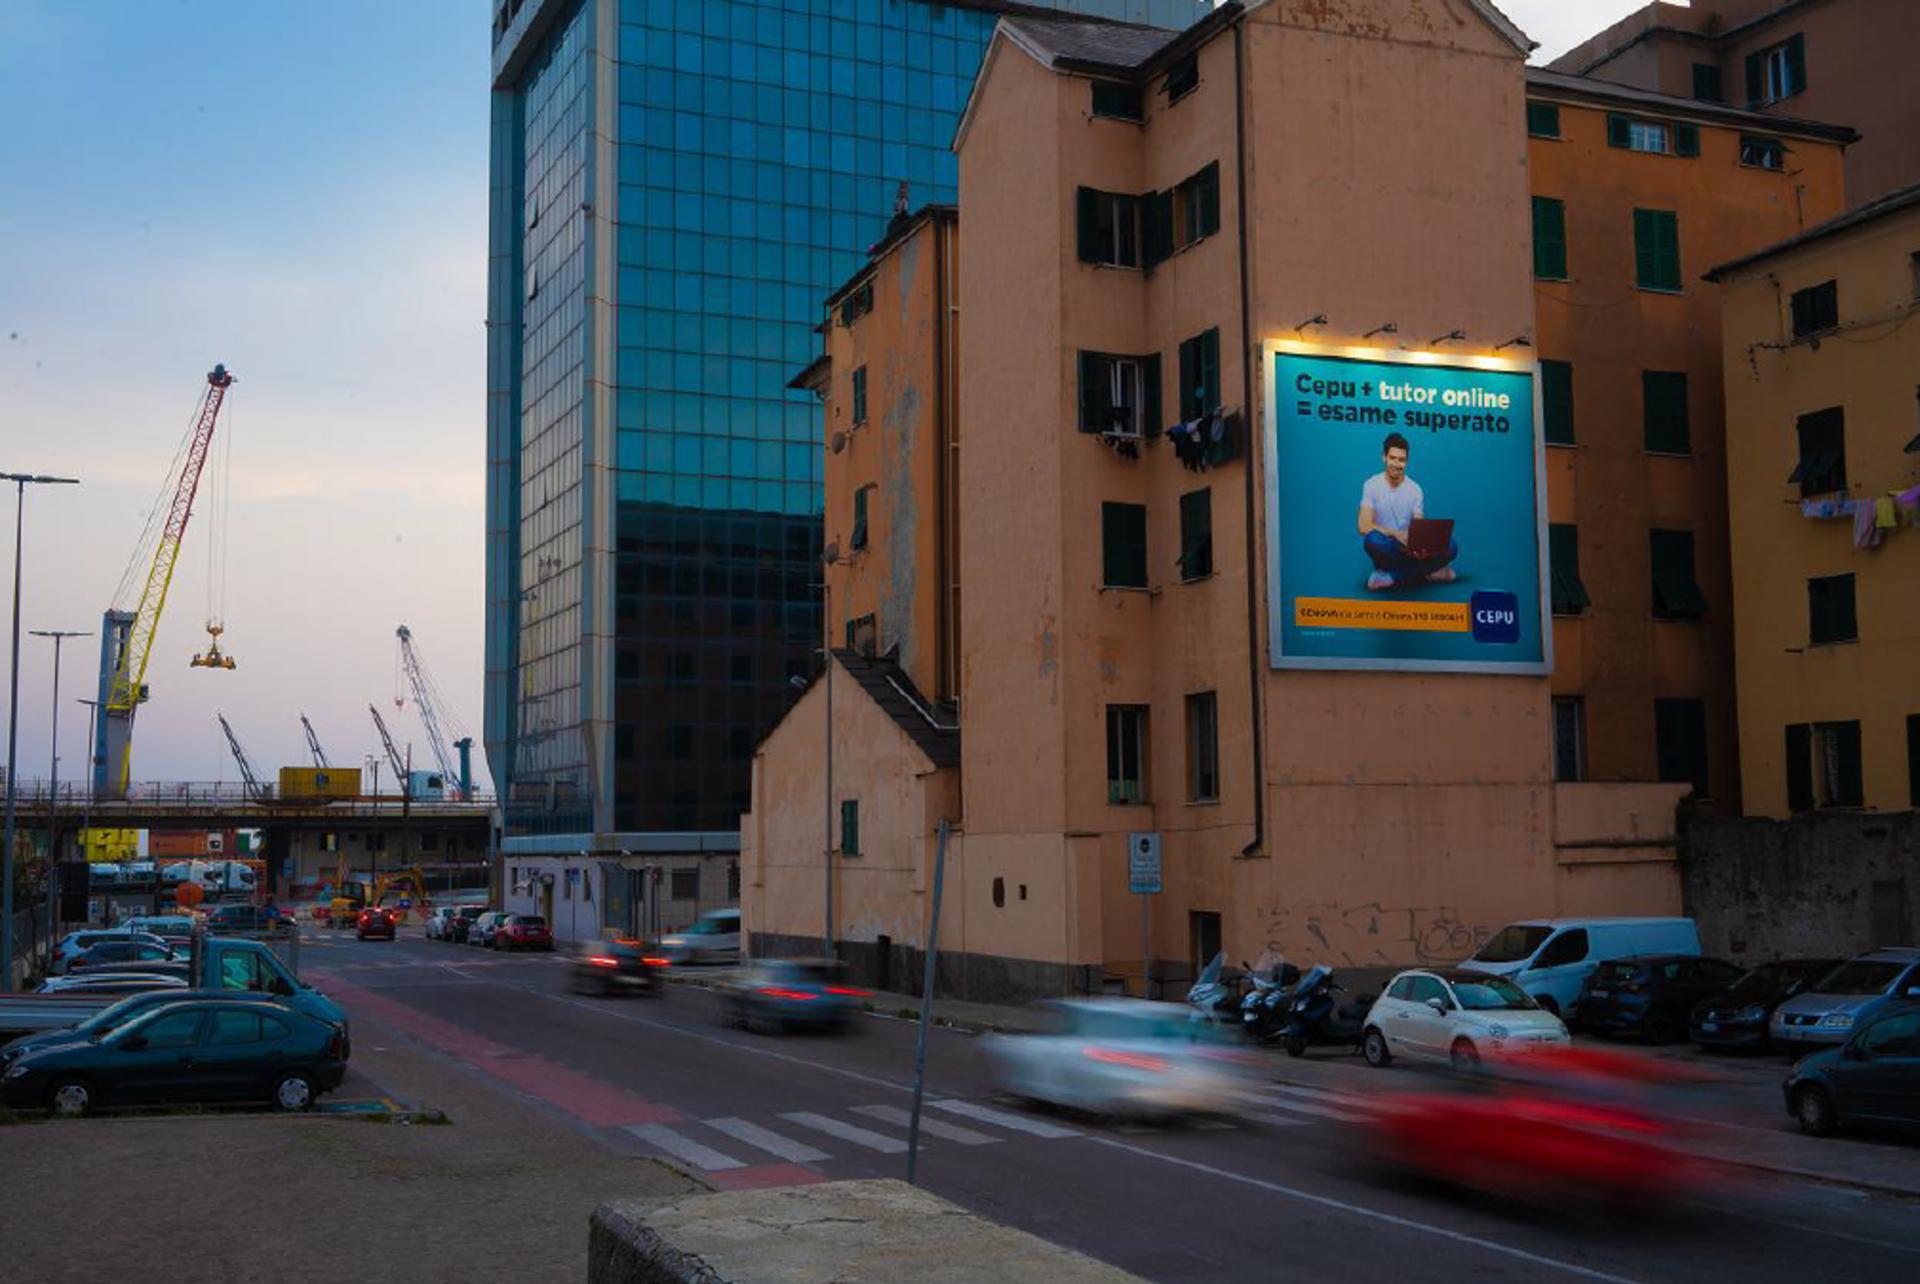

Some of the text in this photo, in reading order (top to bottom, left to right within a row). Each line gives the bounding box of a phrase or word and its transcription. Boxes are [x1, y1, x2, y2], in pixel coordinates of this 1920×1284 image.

[1296, 373, 1510, 409] Cepu + tutor online
[1297, 401, 1510, 433] = esame superato
[1476, 609, 1514, 624] CEPU
